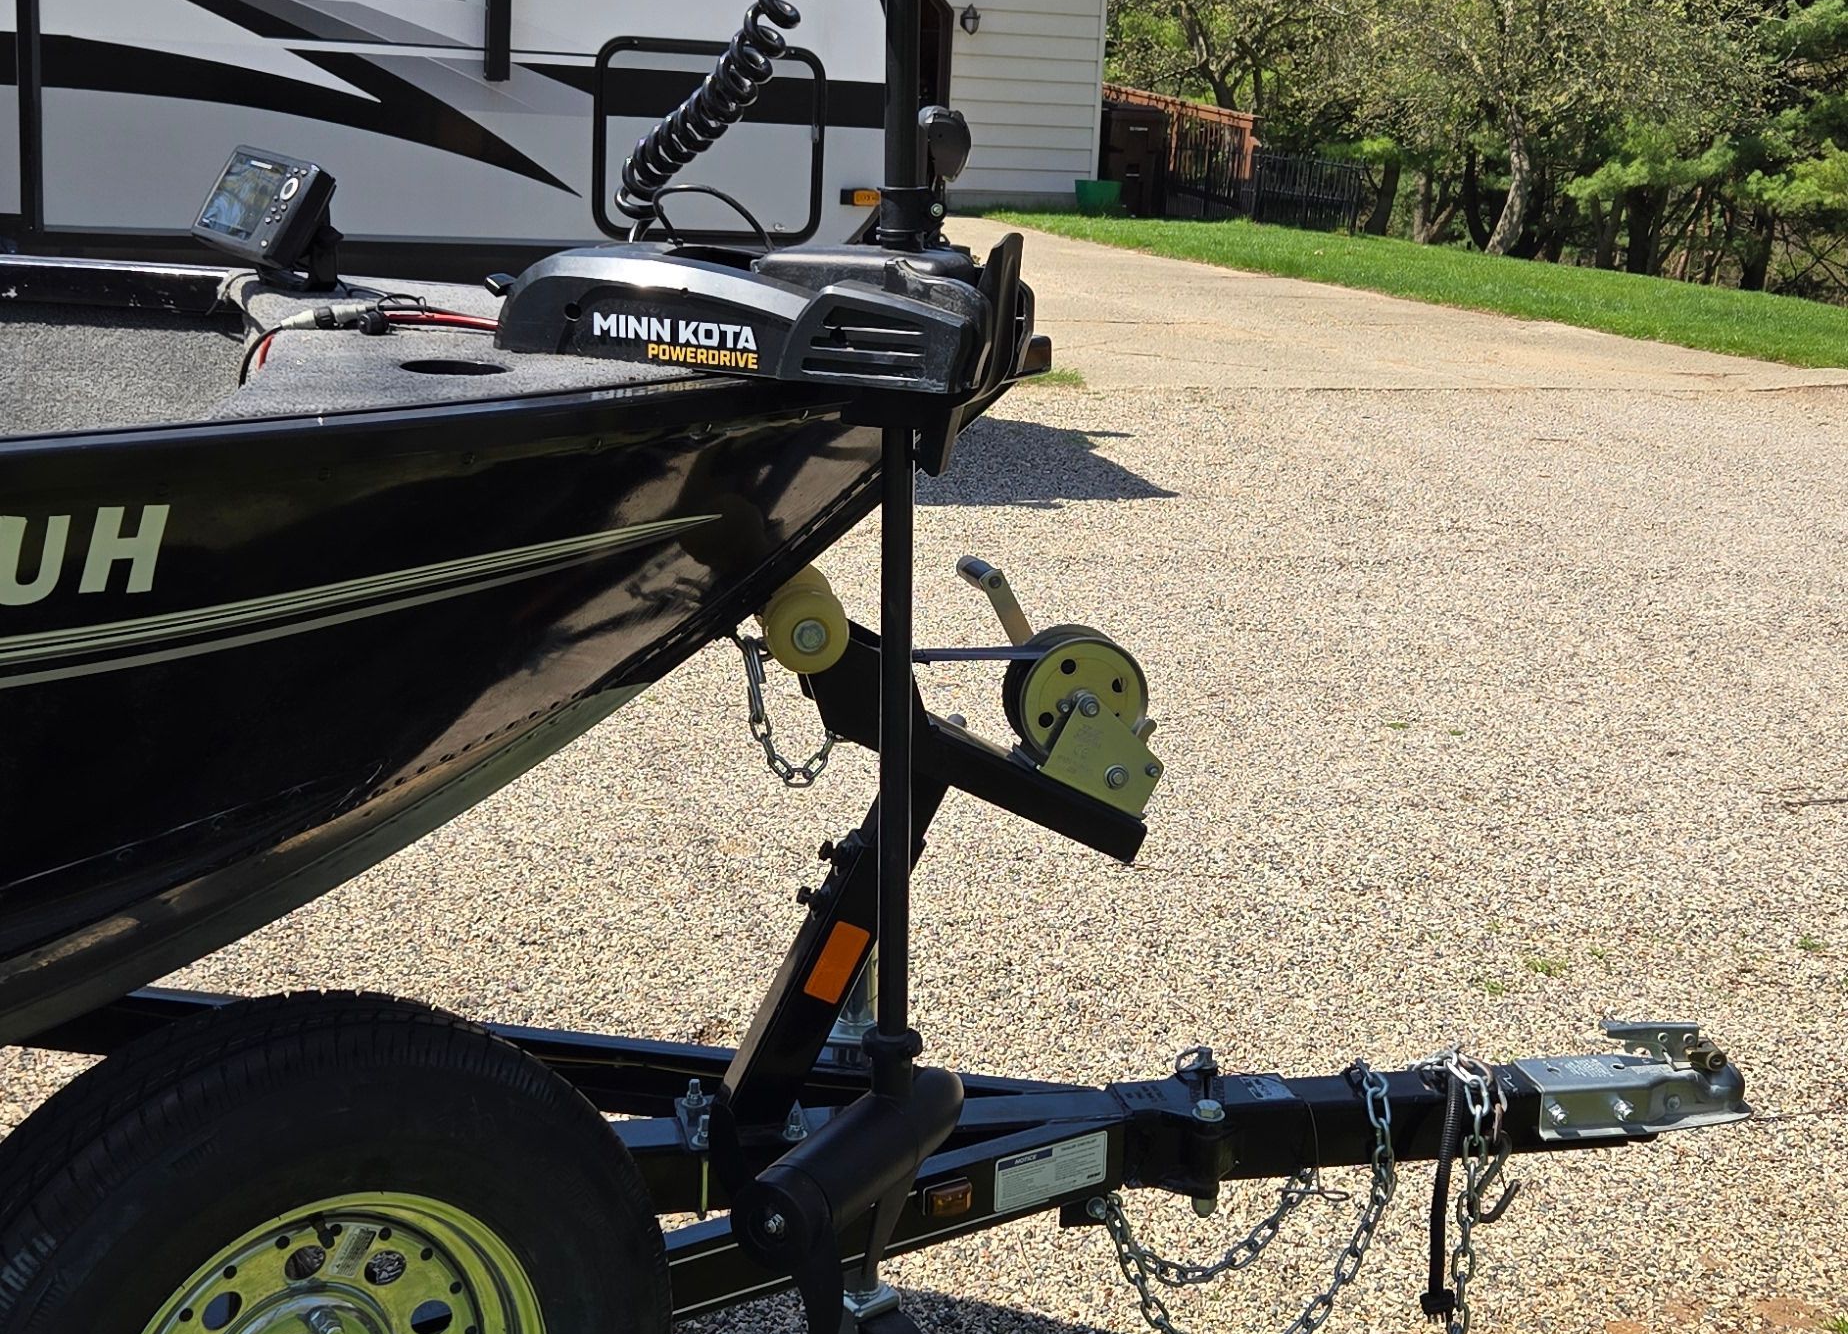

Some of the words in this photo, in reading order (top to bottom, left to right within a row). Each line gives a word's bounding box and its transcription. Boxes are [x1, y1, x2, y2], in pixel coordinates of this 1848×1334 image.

[593, 312, 671, 343] MINN
[678, 320, 757, 351] KOTA
[648, 343, 758, 369] POWERDRIVE
[1014, 1153, 1038, 1165] NOTICE
